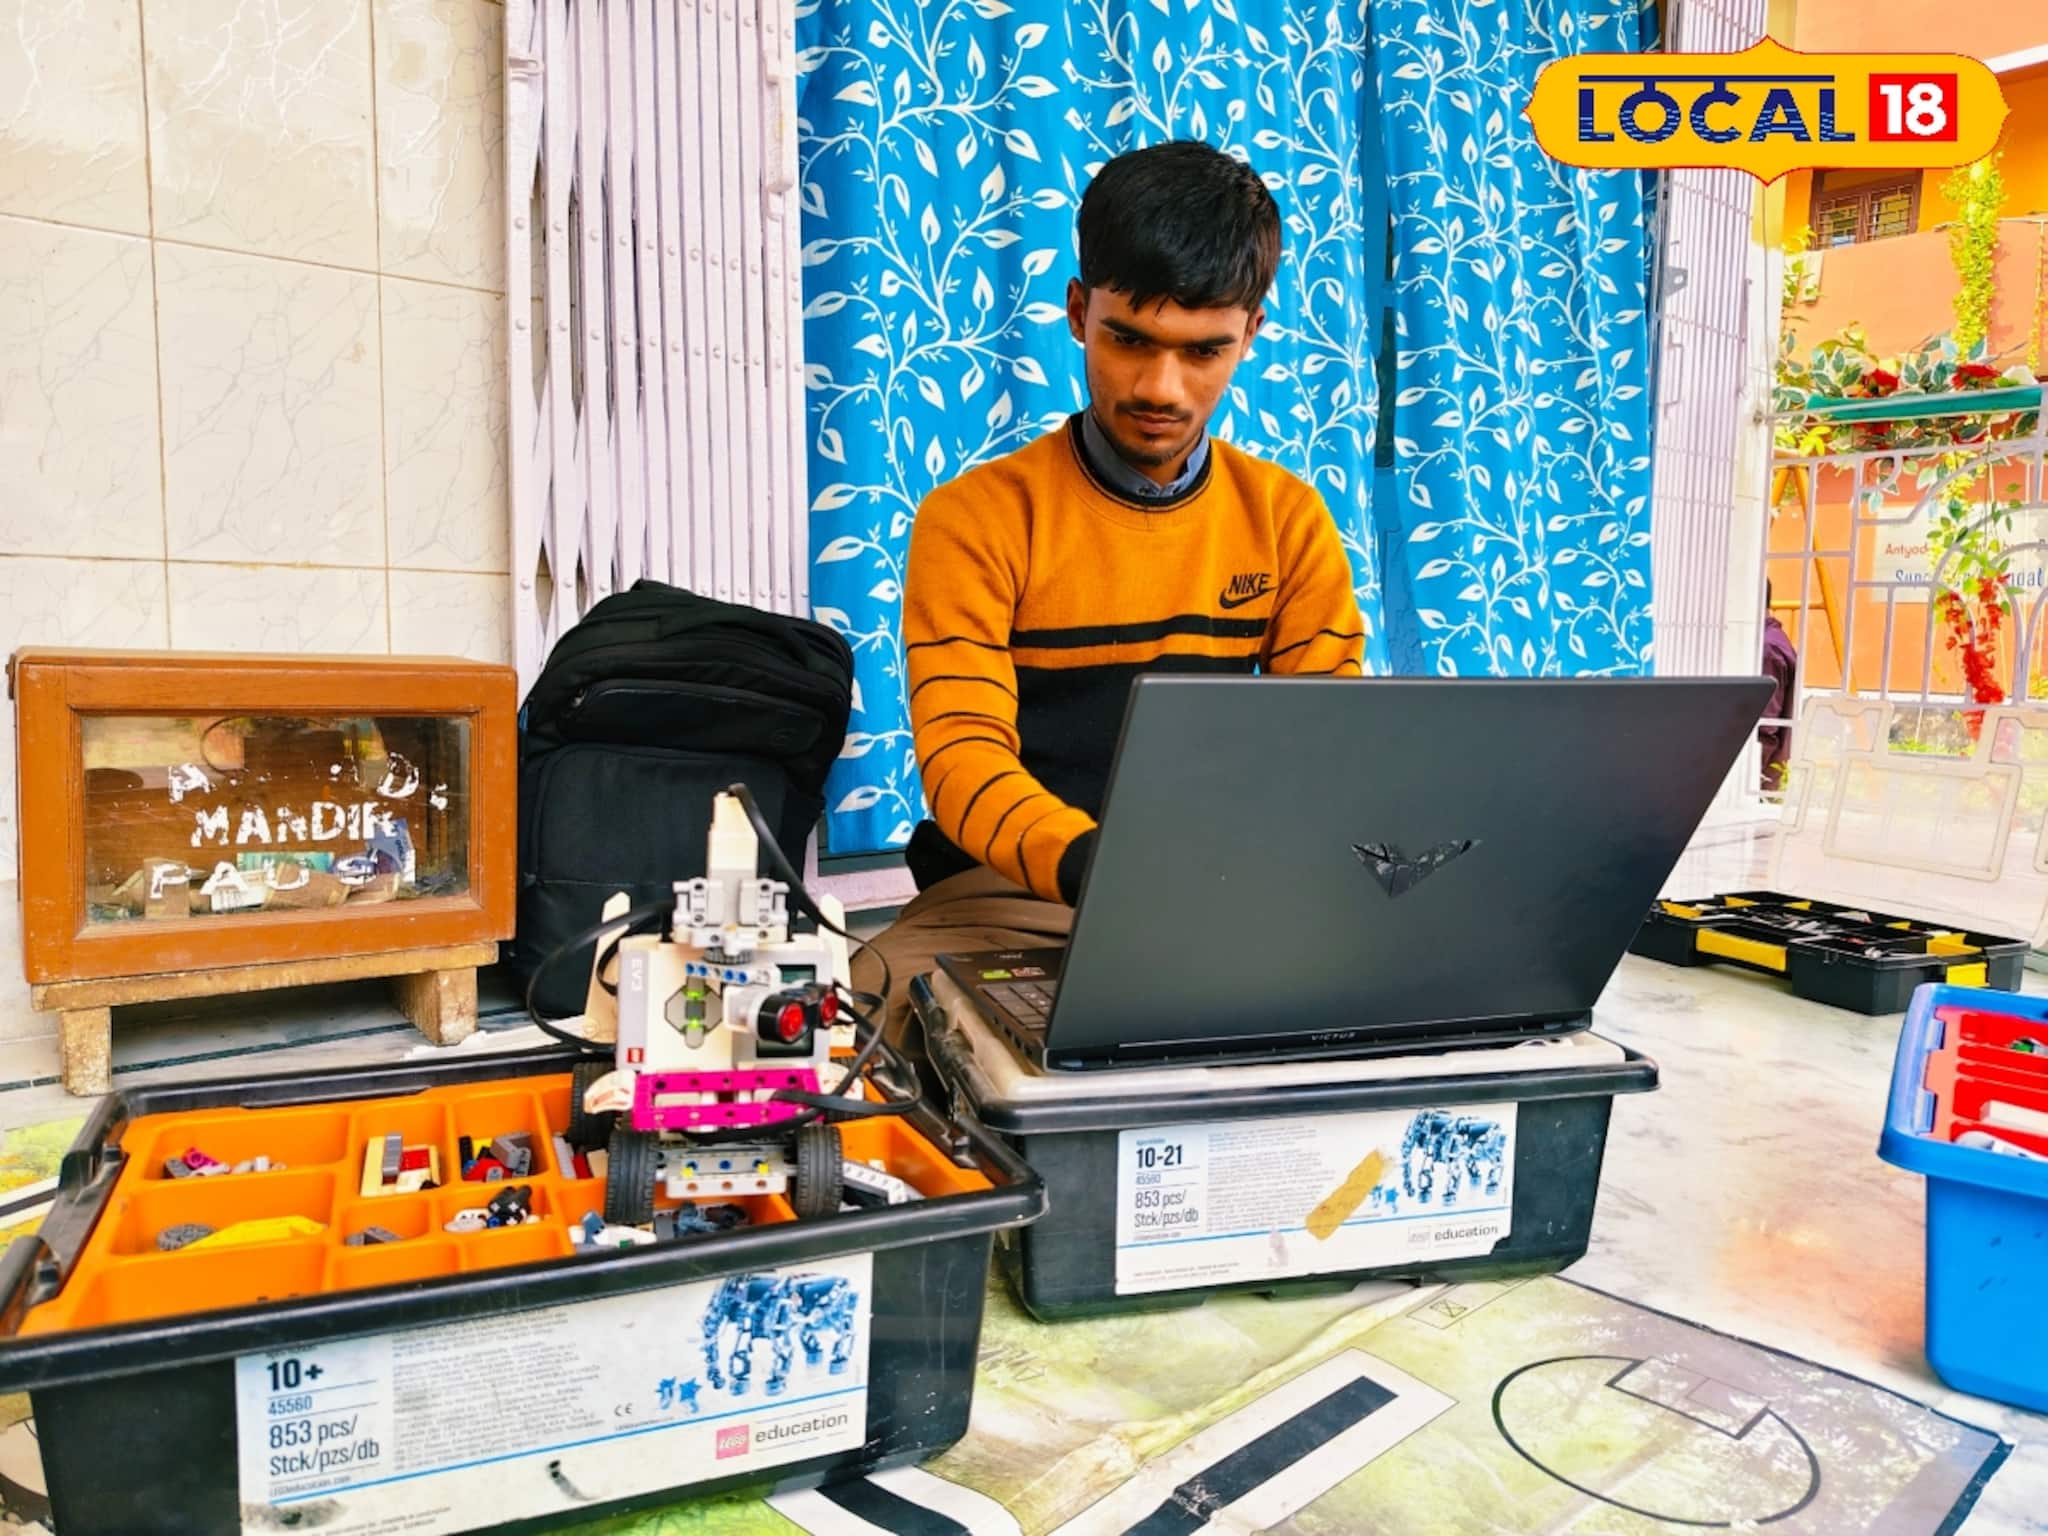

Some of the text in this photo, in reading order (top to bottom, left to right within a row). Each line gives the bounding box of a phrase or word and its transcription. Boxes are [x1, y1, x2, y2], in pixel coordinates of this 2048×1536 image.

[1228, 573, 1271, 595] NIKE
[191, 800, 397, 848] MANDIR
[1136, 1144, 1183, 1168] 10-21
[1135, 1189, 1187, 1209] 853 pcs/
[1134, 1207, 1199, 1228] Stck/pzs/db
[1434, 1225, 1499, 1241] education
[267, 1358, 323, 1391] 10+
[268, 1395, 313, 1416] 45560
[269, 1413, 358, 1449] 853 pcs/
[755, 1412, 848, 1443] education
[270, 1437, 380, 1476] Stck/pzs/db
